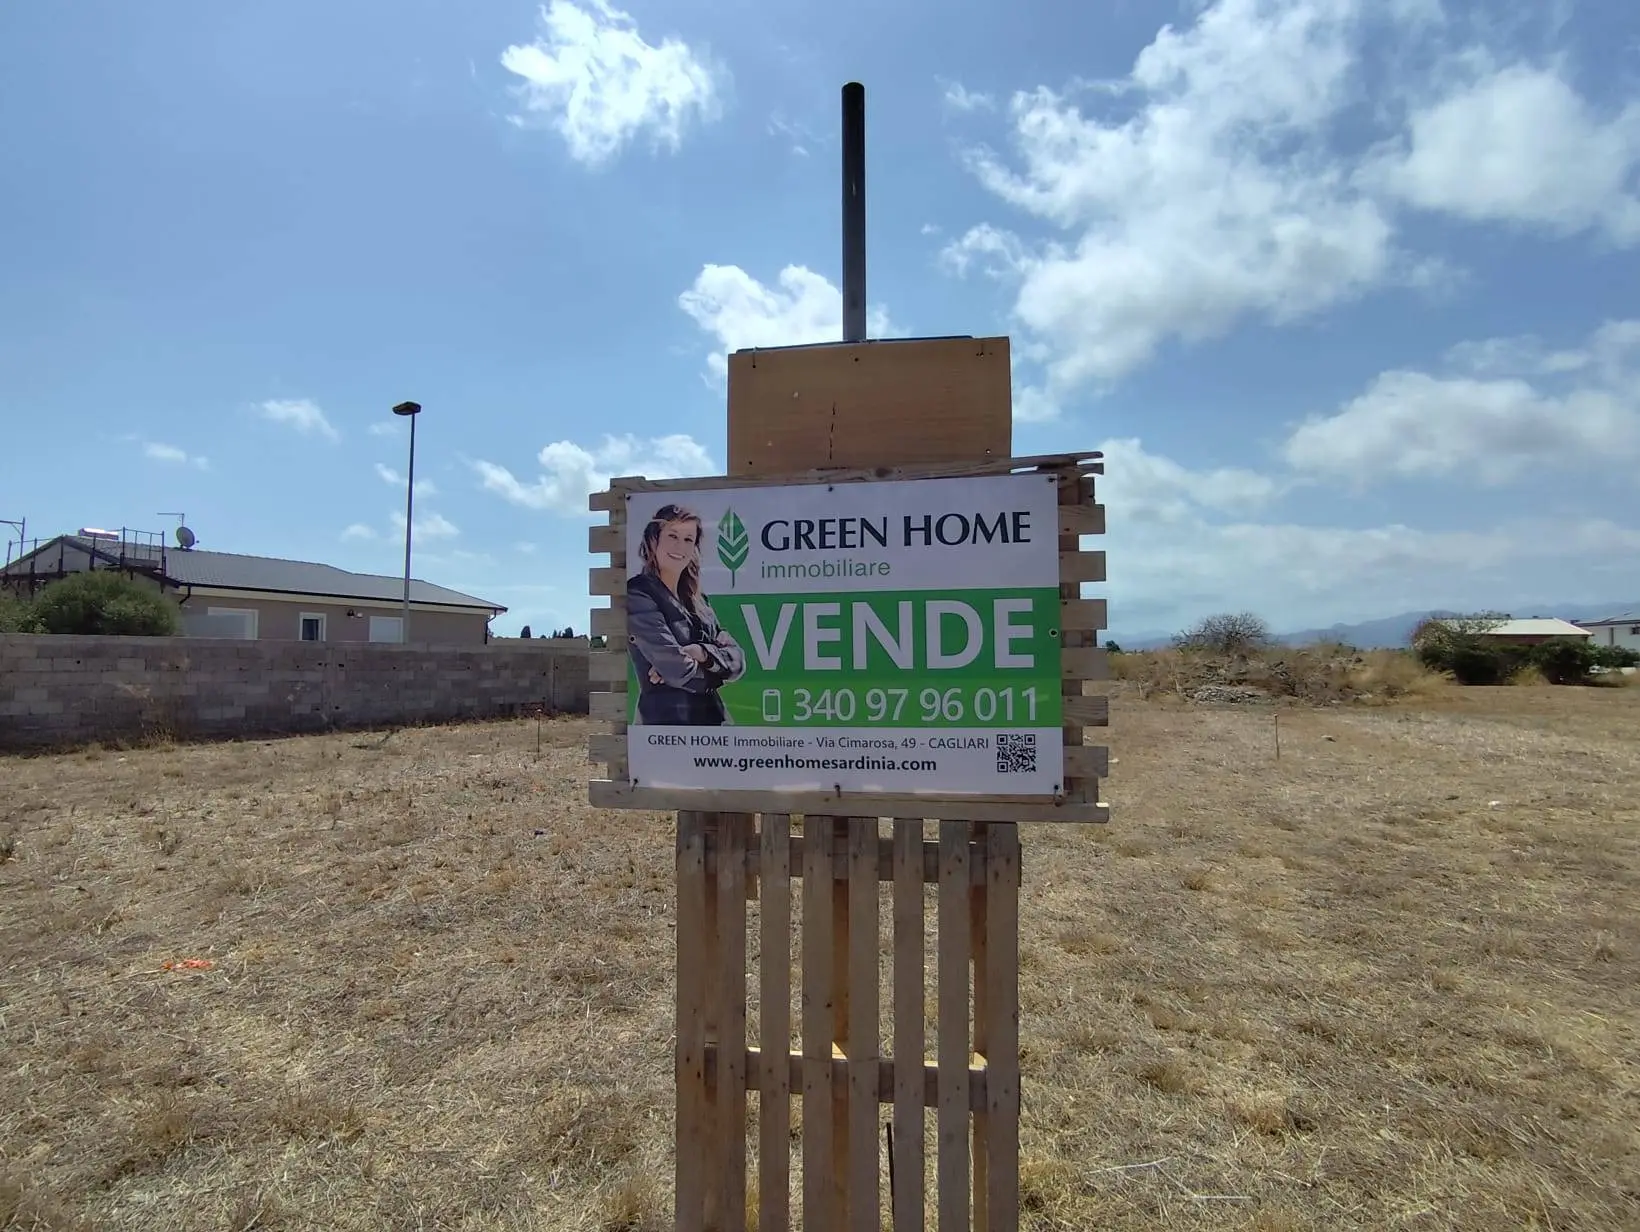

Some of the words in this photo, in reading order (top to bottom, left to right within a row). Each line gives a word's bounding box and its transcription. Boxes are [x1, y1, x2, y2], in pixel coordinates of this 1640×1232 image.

[760, 516, 888, 552] GREEN
[903, 511, 1031, 547] HOME
[760, 558, 891, 579] immobiliare
[740, 598, 1034, 671] VENDE
[792, 688, 856, 721] 340
[865, 687, 909, 721] 97
[918, 687, 964, 721] 96
[973, 686, 1037, 721] 011
[647, 734, 687, 746] GREEN
[690, 735, 729, 747] HOME
[733, 735, 805, 748] Immobiliare
[816, 736, 835, 748] Via
[838, 736, 899, 750] Cimarosa,
[901, 737, 916, 749] 49
[928, 737, 989, 749] CAGLIARI
[693, 754, 937, 772] www.greenhomesardinia.com
